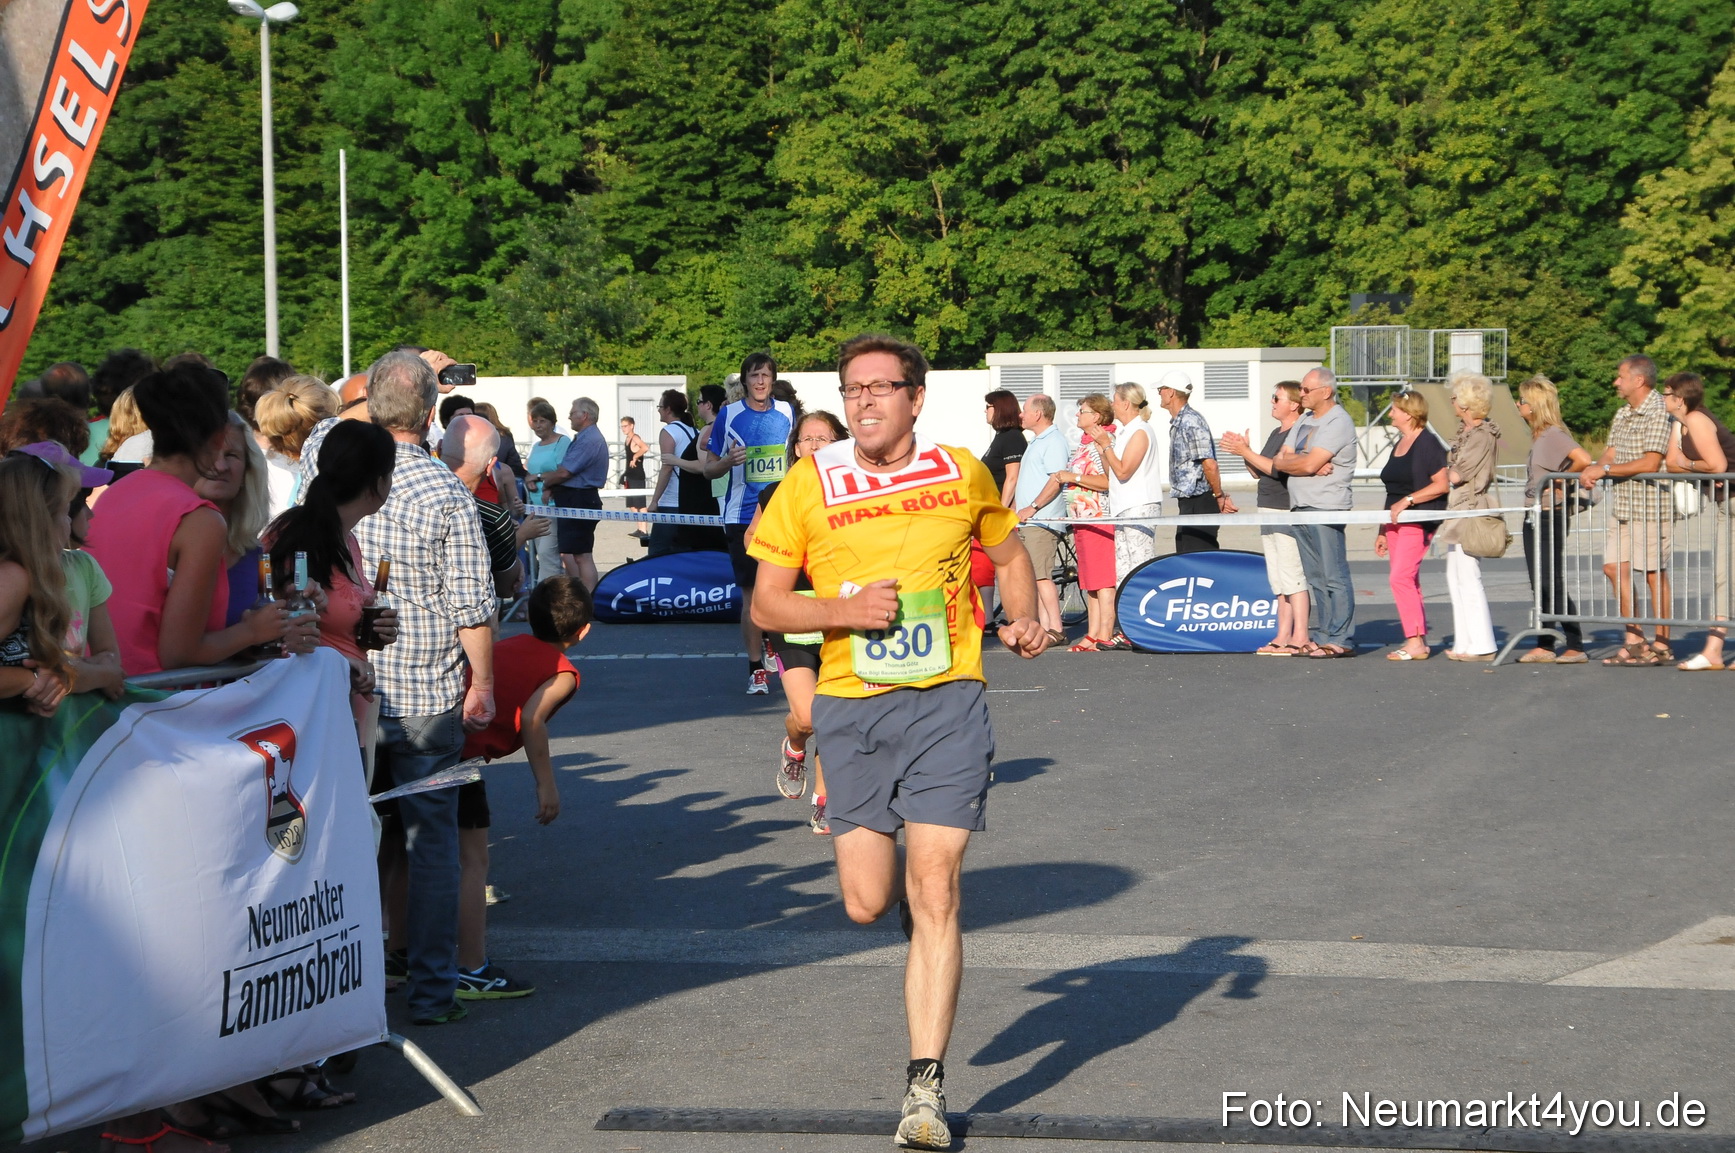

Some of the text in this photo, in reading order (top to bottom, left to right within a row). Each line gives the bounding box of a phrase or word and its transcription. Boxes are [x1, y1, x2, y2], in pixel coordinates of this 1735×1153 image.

[748, 457, 782, 473] 1041
[827, 489, 967, 531] MAX BÖGL
[636, 583, 736, 613] Fischer
[865, 623, 933, 661] 830
[1176, 619, 1276, 632] AUTOMOBILE
[274, 825, 300, 849] 1628
[247, 879, 344, 952] Neumarkter
[219, 928, 362, 1038] Lammsbräu
